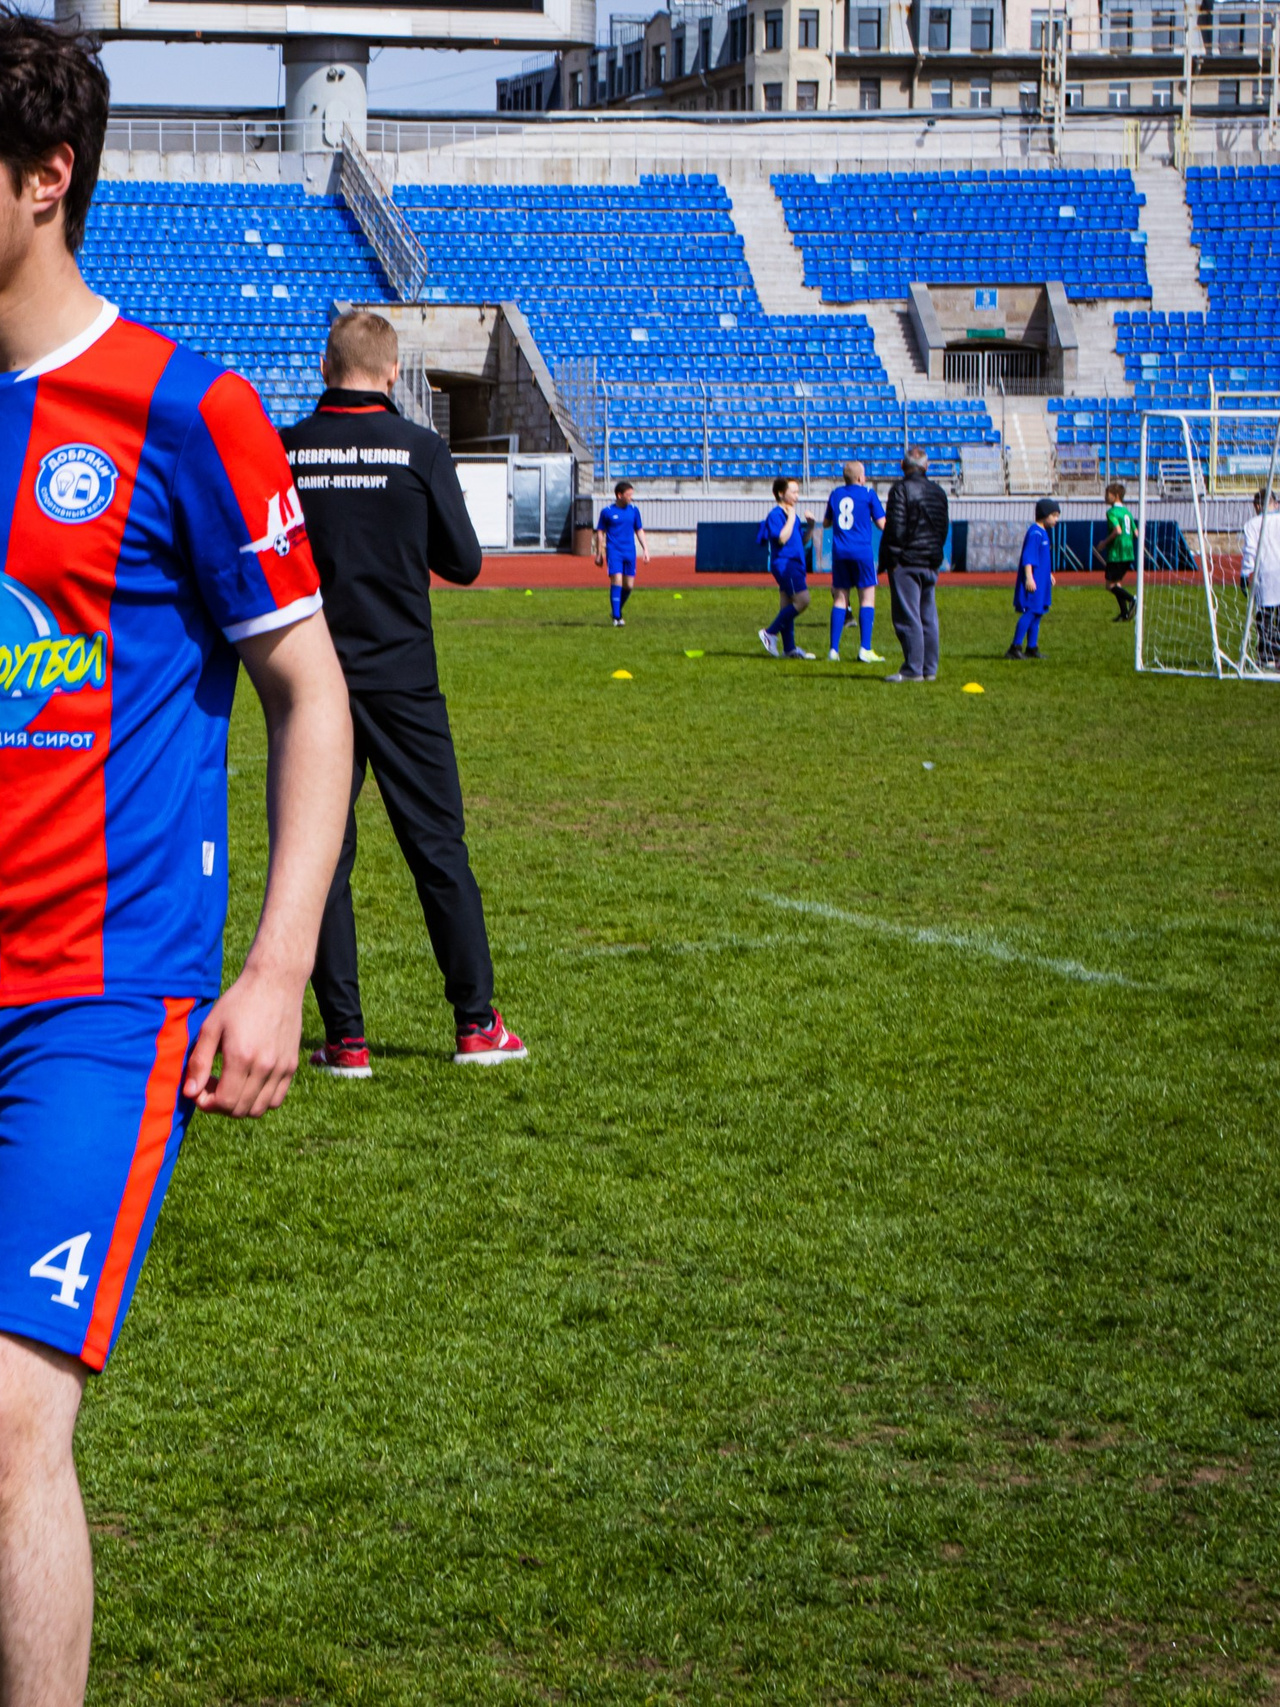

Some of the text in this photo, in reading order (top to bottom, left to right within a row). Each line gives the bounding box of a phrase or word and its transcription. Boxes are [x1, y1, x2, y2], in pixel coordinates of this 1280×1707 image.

[48, 449, 111, 477] ДОБРЯКИ
[297, 446, 358, 465] СЕВЕРНЫЙ
[360, 447, 410, 466] ЧЕЛОВЕК
[297, 474, 388, 490] САНКТ-ПЕТЕРБУРГ
[838, 497, 854, 530] 8
[32, 731, 93, 748] СИРОТ
[29, 1231, 92, 1309] 4
